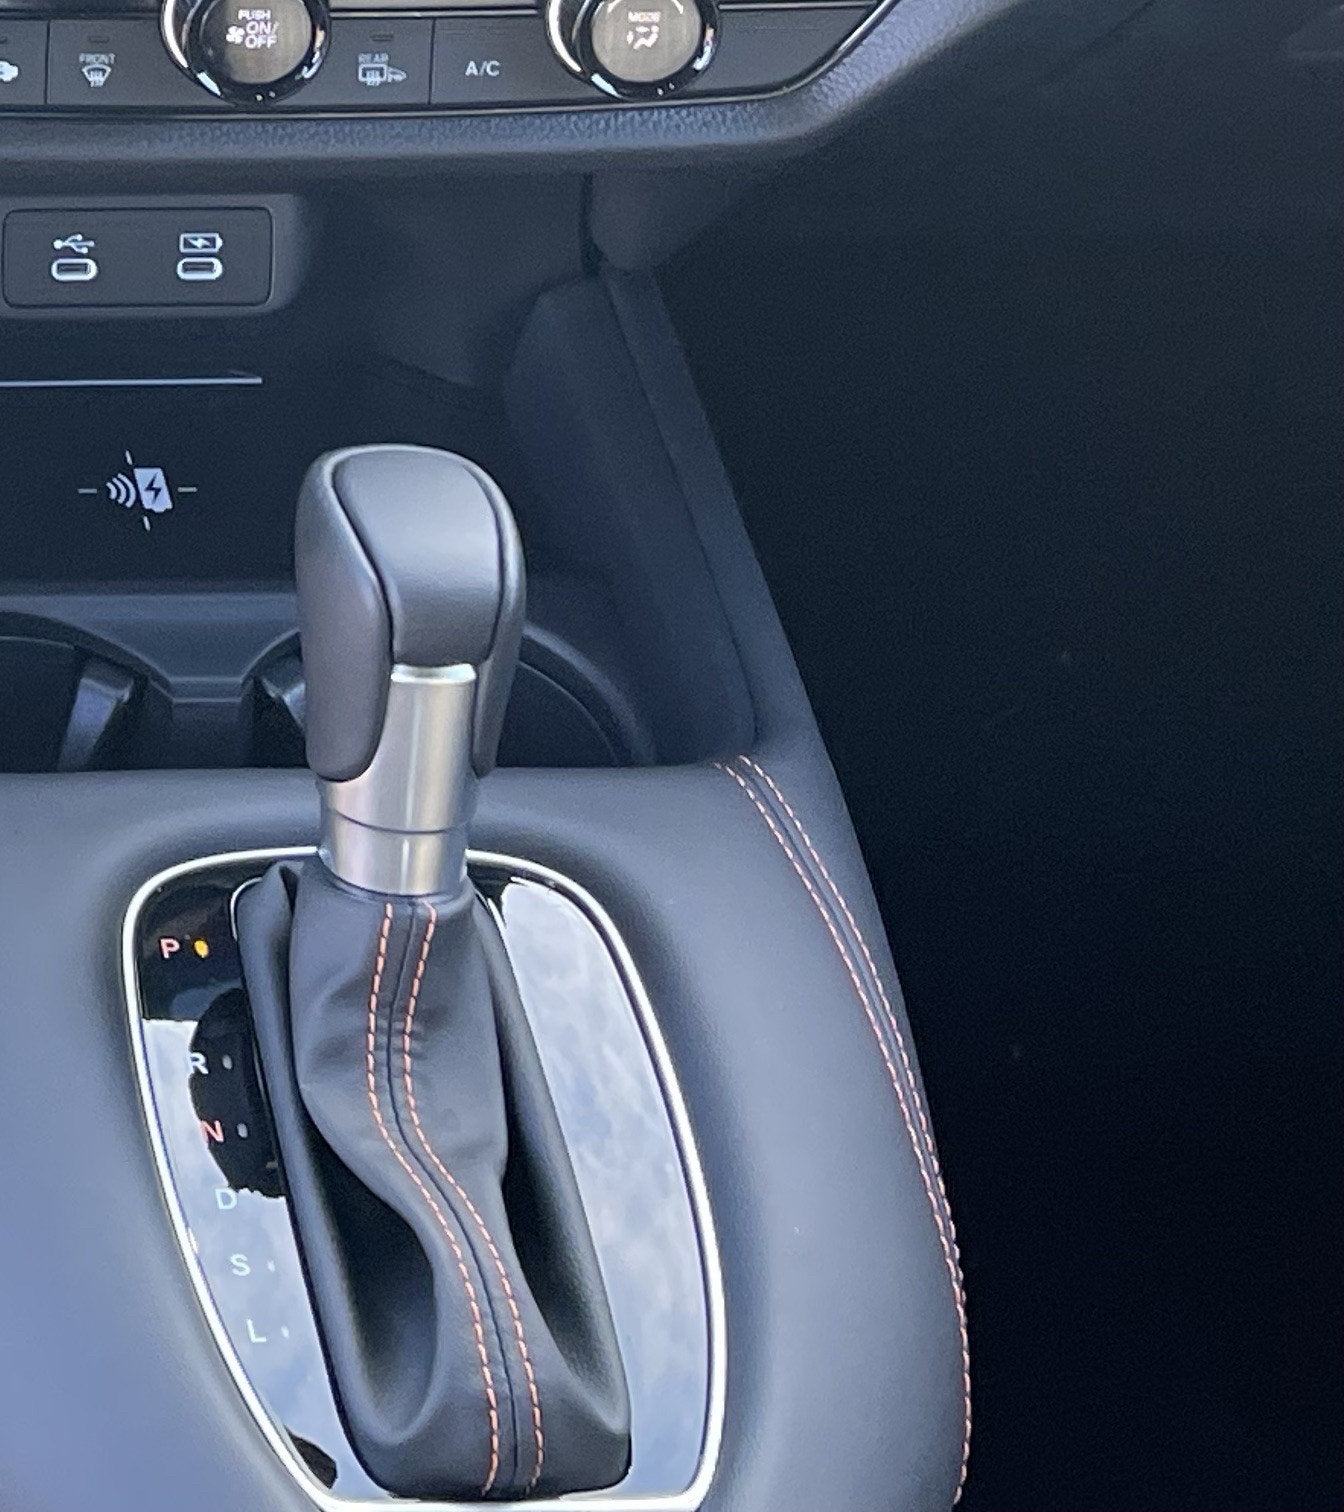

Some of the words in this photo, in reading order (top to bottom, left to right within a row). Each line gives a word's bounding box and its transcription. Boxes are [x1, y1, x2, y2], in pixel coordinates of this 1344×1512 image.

[238, 9, 272, 21] PUSH
[245, 34, 277, 49] OFF
[465, 59, 500, 78] A/C
[160, 936, 180, 959] P
[188, 1052, 209, 1076] R
[200, 1119, 225, 1143] N
[215, 1188, 238, 1210] D
[230, 1254, 251, 1276] S
[246, 1319, 267, 1343] L
